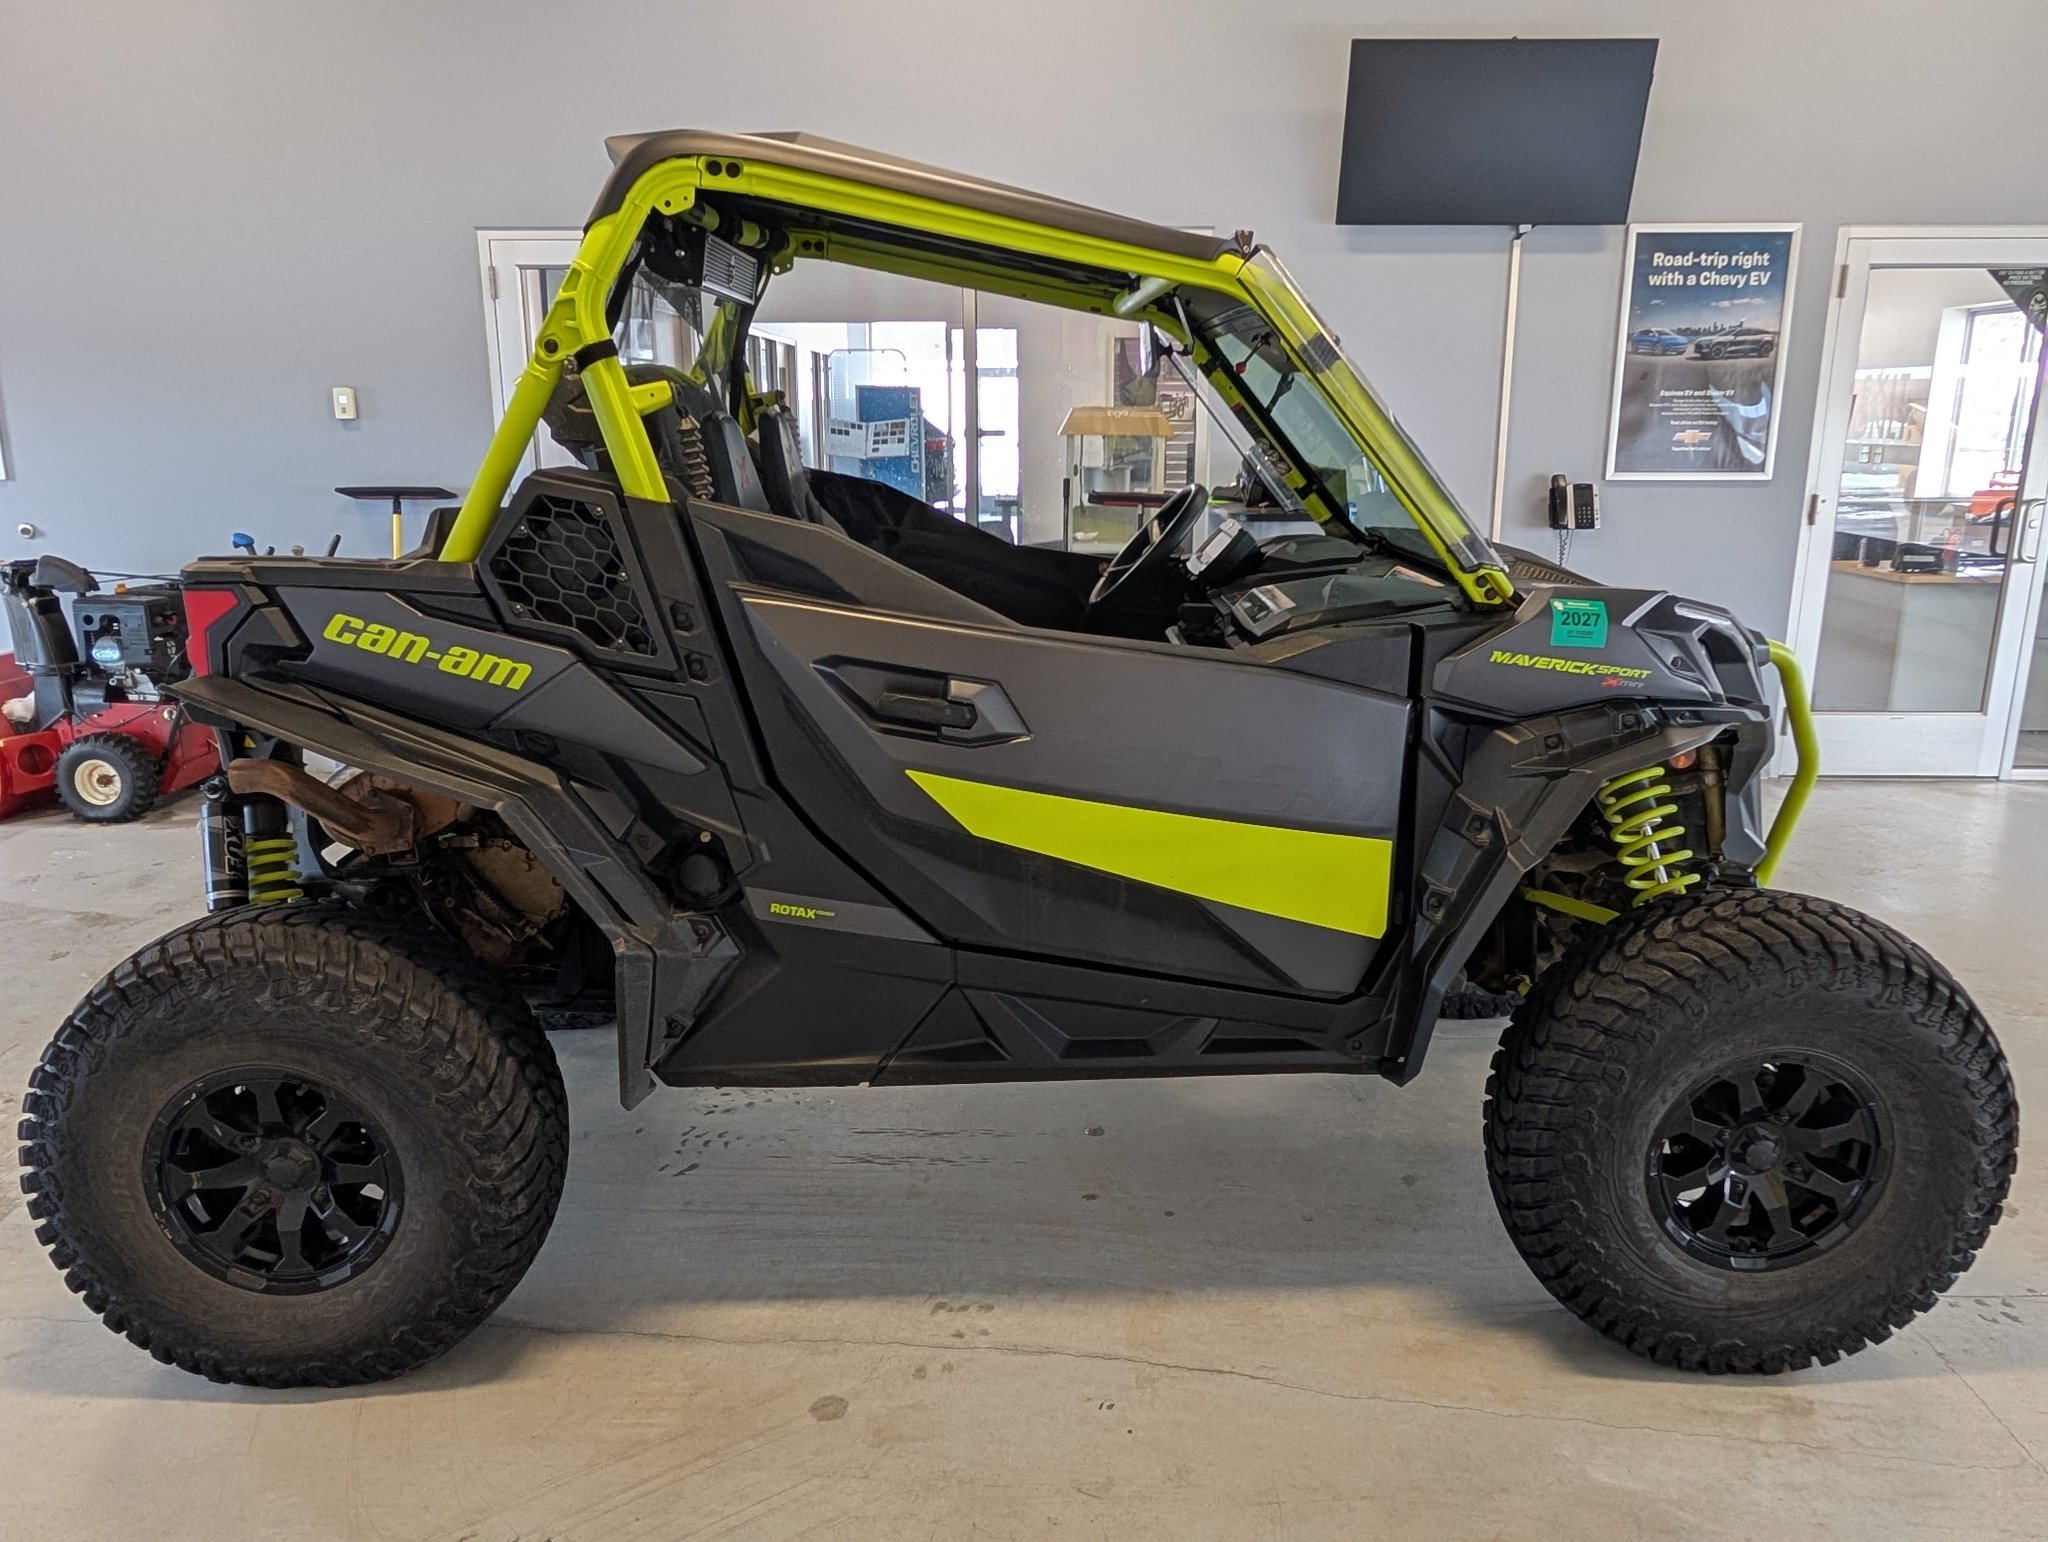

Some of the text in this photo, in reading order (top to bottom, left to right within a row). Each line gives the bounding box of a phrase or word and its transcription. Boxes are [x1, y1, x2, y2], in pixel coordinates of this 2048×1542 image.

[1653, 251, 1771, 269] Road-trip right
[1648, 271, 1771, 288] with a Chevy EV
[909, 392, 920, 474] CHEVROLET
[1560, 611, 1601, 627] 2027
[323, 613, 533, 691] can-am
[1489, 650, 1653, 679] MAVERICK SPORT
[223, 815, 246, 876] FOX
[770, 903, 816, 919] ROTAX
